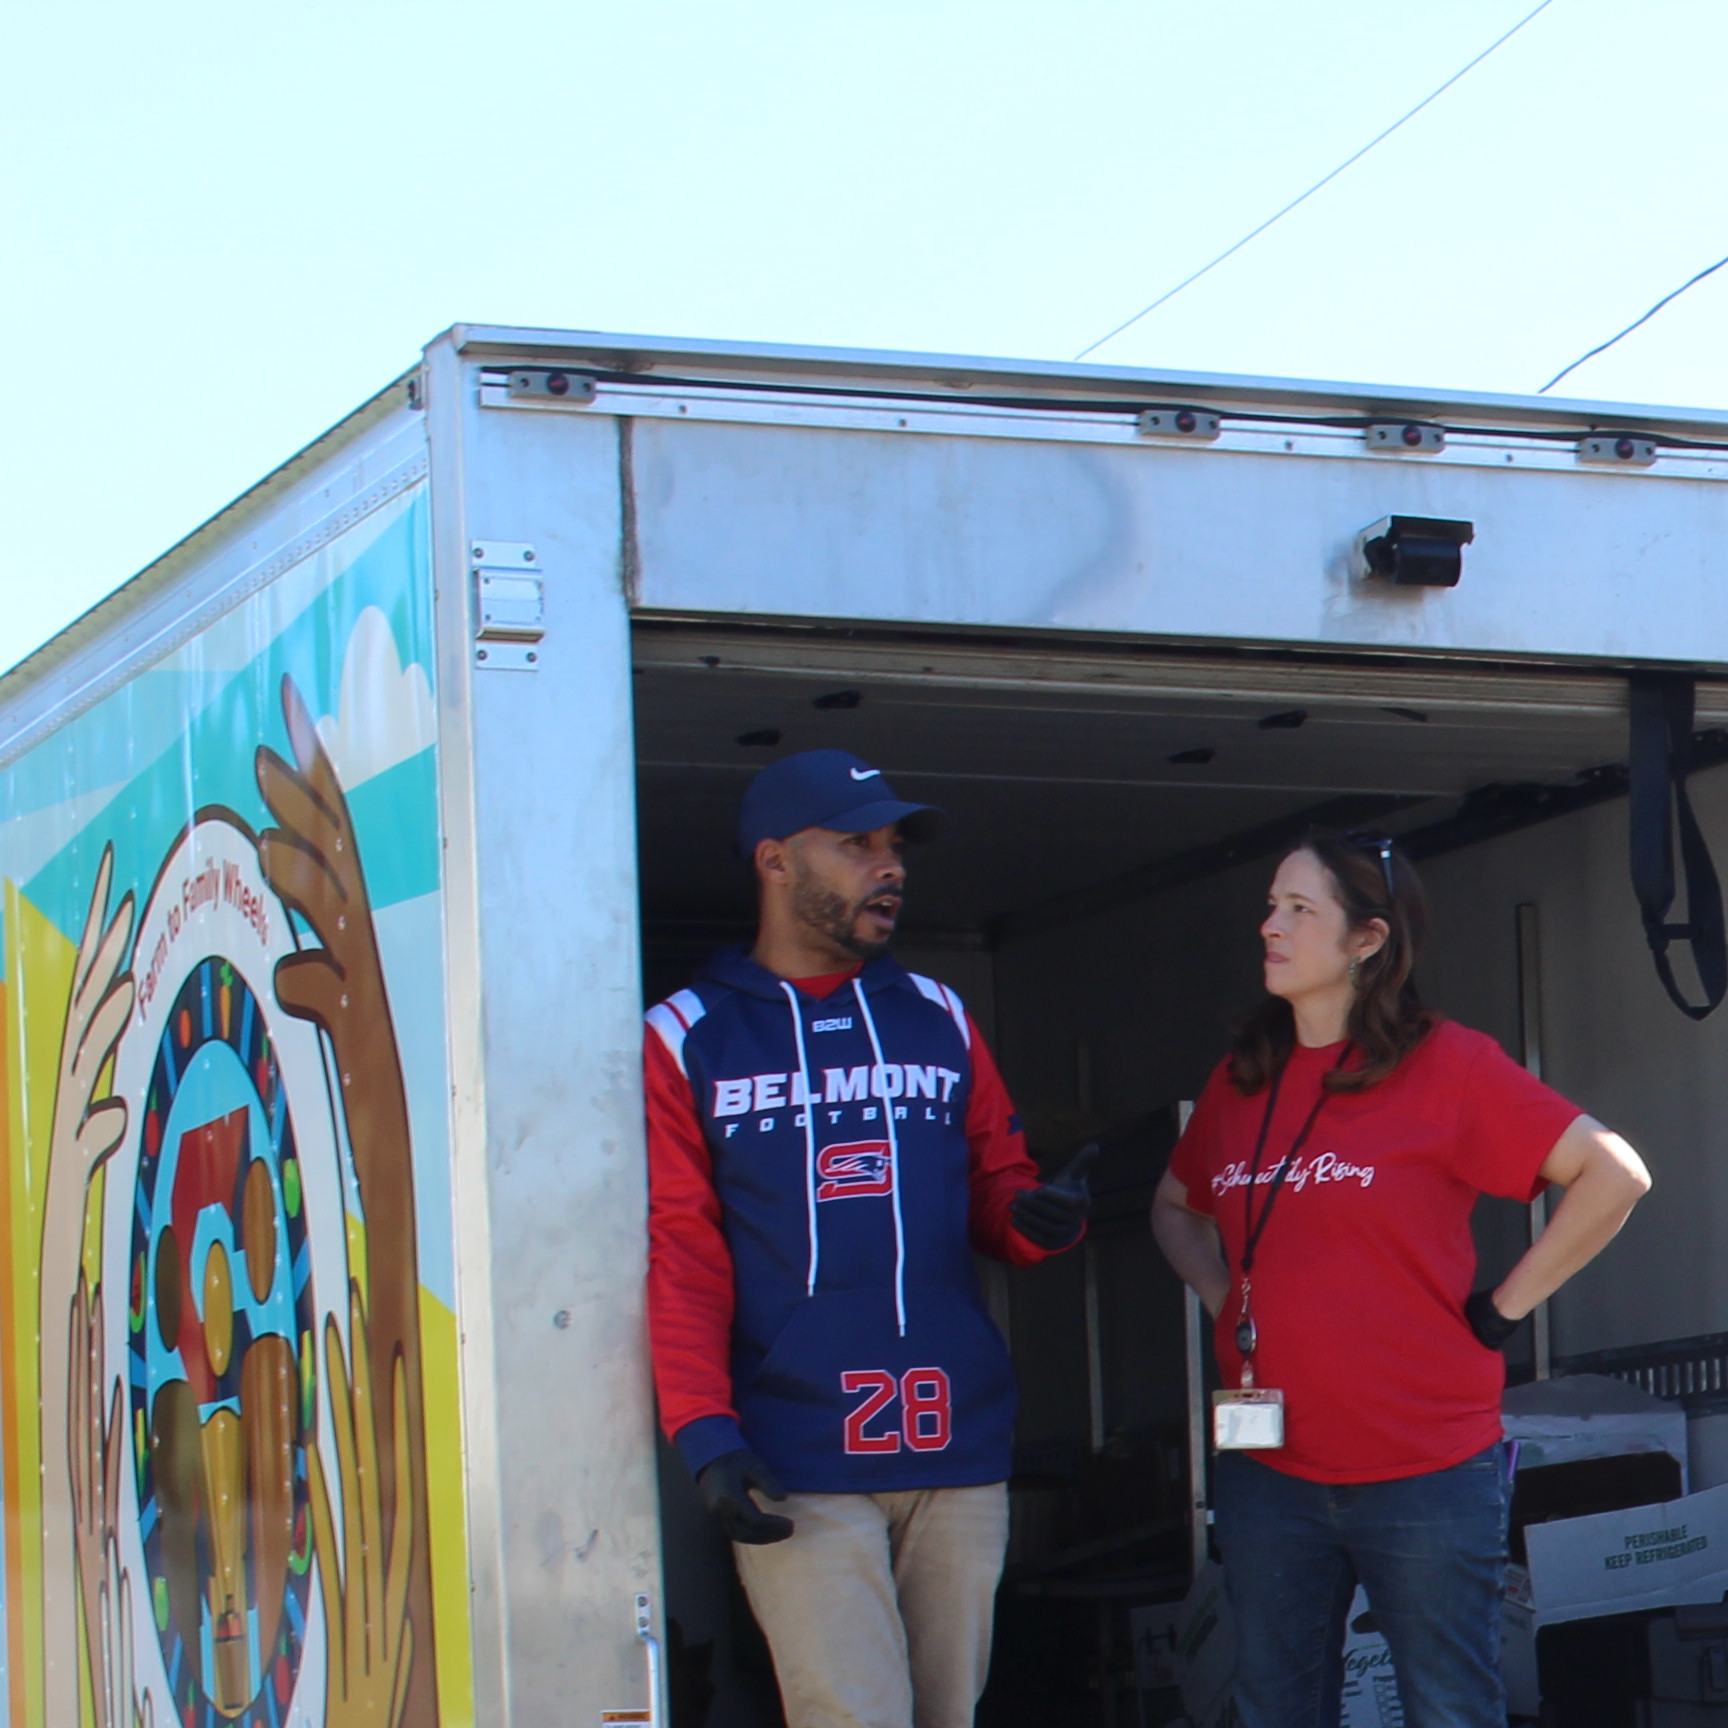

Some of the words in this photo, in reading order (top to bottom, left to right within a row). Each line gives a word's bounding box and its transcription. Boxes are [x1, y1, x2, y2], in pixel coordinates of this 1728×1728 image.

[138, 932, 168, 1020] Farm
[168, 905, 181, 943] to
[183, 856, 220, 921] Family
[224, 860, 269, 946] Wheels
[713, 1063, 961, 1118] BELMONT
[725, 1106, 952, 1139] FOOTBALL
[839, 1366, 953, 1455] 28
[1603, 1552, 1634, 1571] KEEP
[1634, 1535, 1709, 1566] REFRIGERATED
[1624, 1523, 1688, 1551] PERISHABLE
